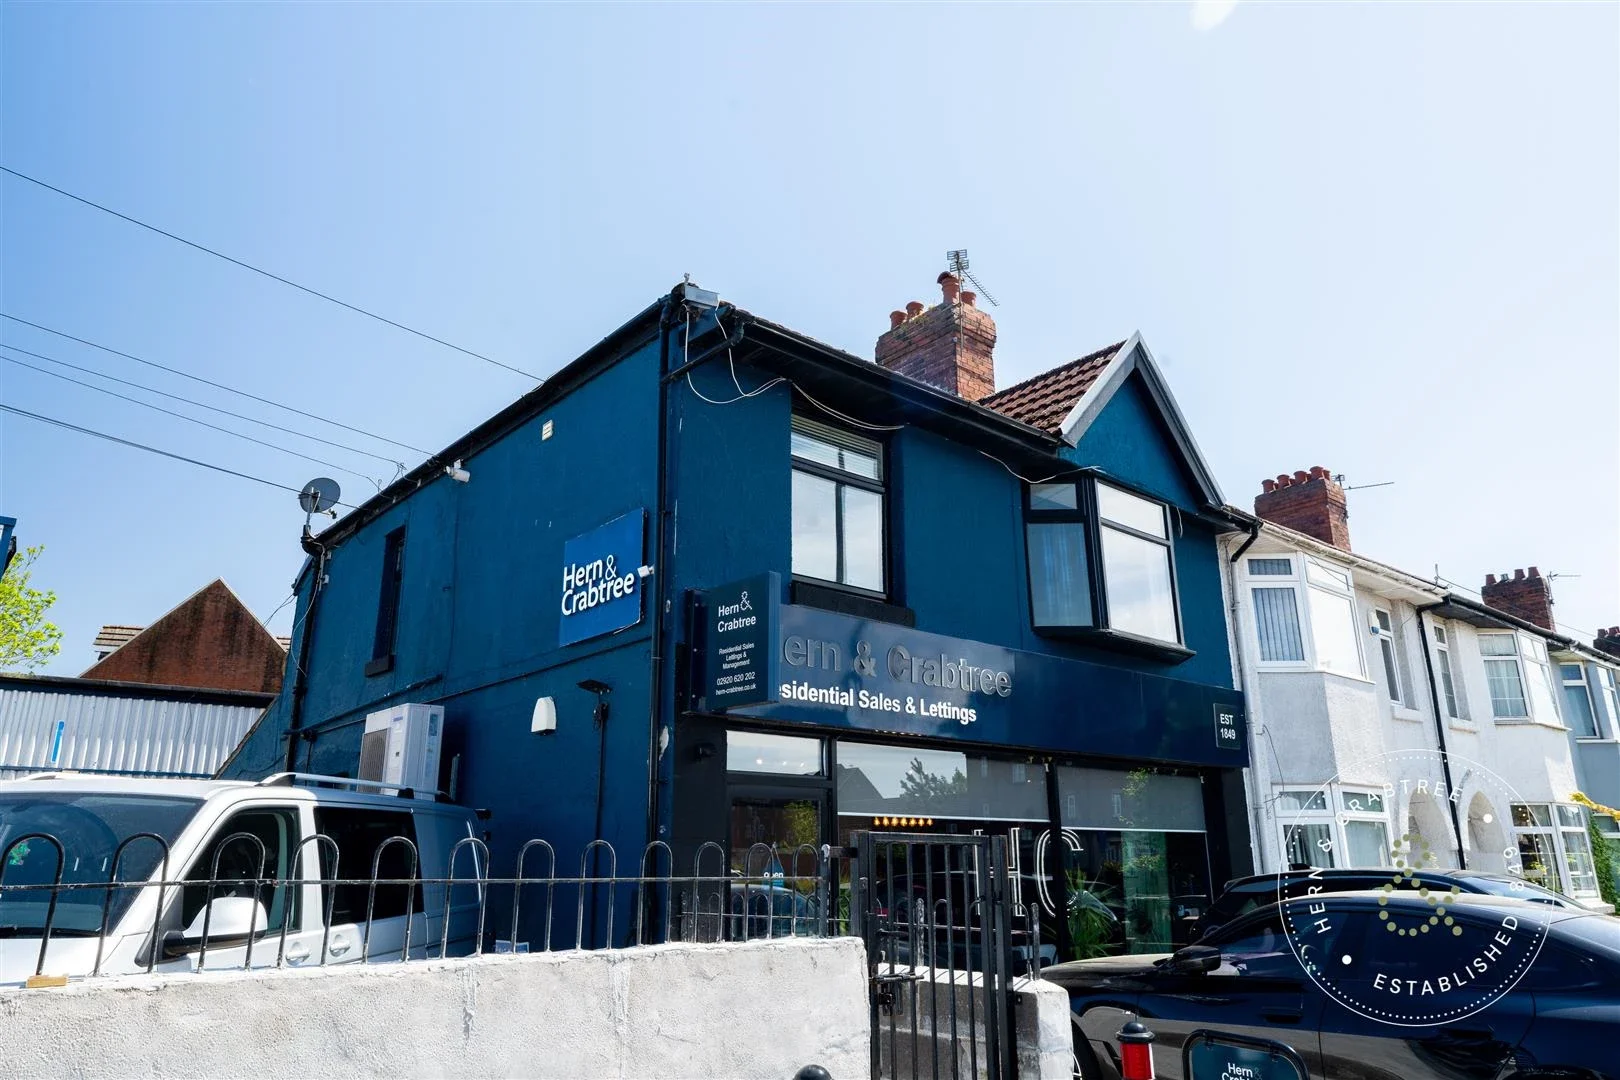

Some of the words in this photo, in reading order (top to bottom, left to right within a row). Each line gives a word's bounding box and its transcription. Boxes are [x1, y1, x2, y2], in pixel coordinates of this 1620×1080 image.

[563, 559, 603, 593] Hern
[605, 554, 617, 581] &
[561, 573, 635, 616] Crabtree
[718, 604, 740, 617] Hern
[740, 590, 753, 611] &
[717, 615, 757, 633] Crabtree
[718, 644, 742, 656] Residential
[742, 642, 755, 651] Sales
[742, 650, 748, 658] &
[779, 635, 841, 672] ern
[854, 639, 878, 678] &
[887, 644, 1012, 698] Crabtree
[716, 675, 734, 686] 02920
[733, 673, 745, 683] 620
[744, 671, 756, 681] 202
[779, 680, 855, 707] sidential
[858, 689, 901, 713] Sales
[905, 696, 917, 715] &
[920, 698, 977, 725] Lettings
[1219, 713, 1234, 726] EST
[1220, 727, 1236, 740] 1849
[1227, 1062, 1253, 1078] Hern
